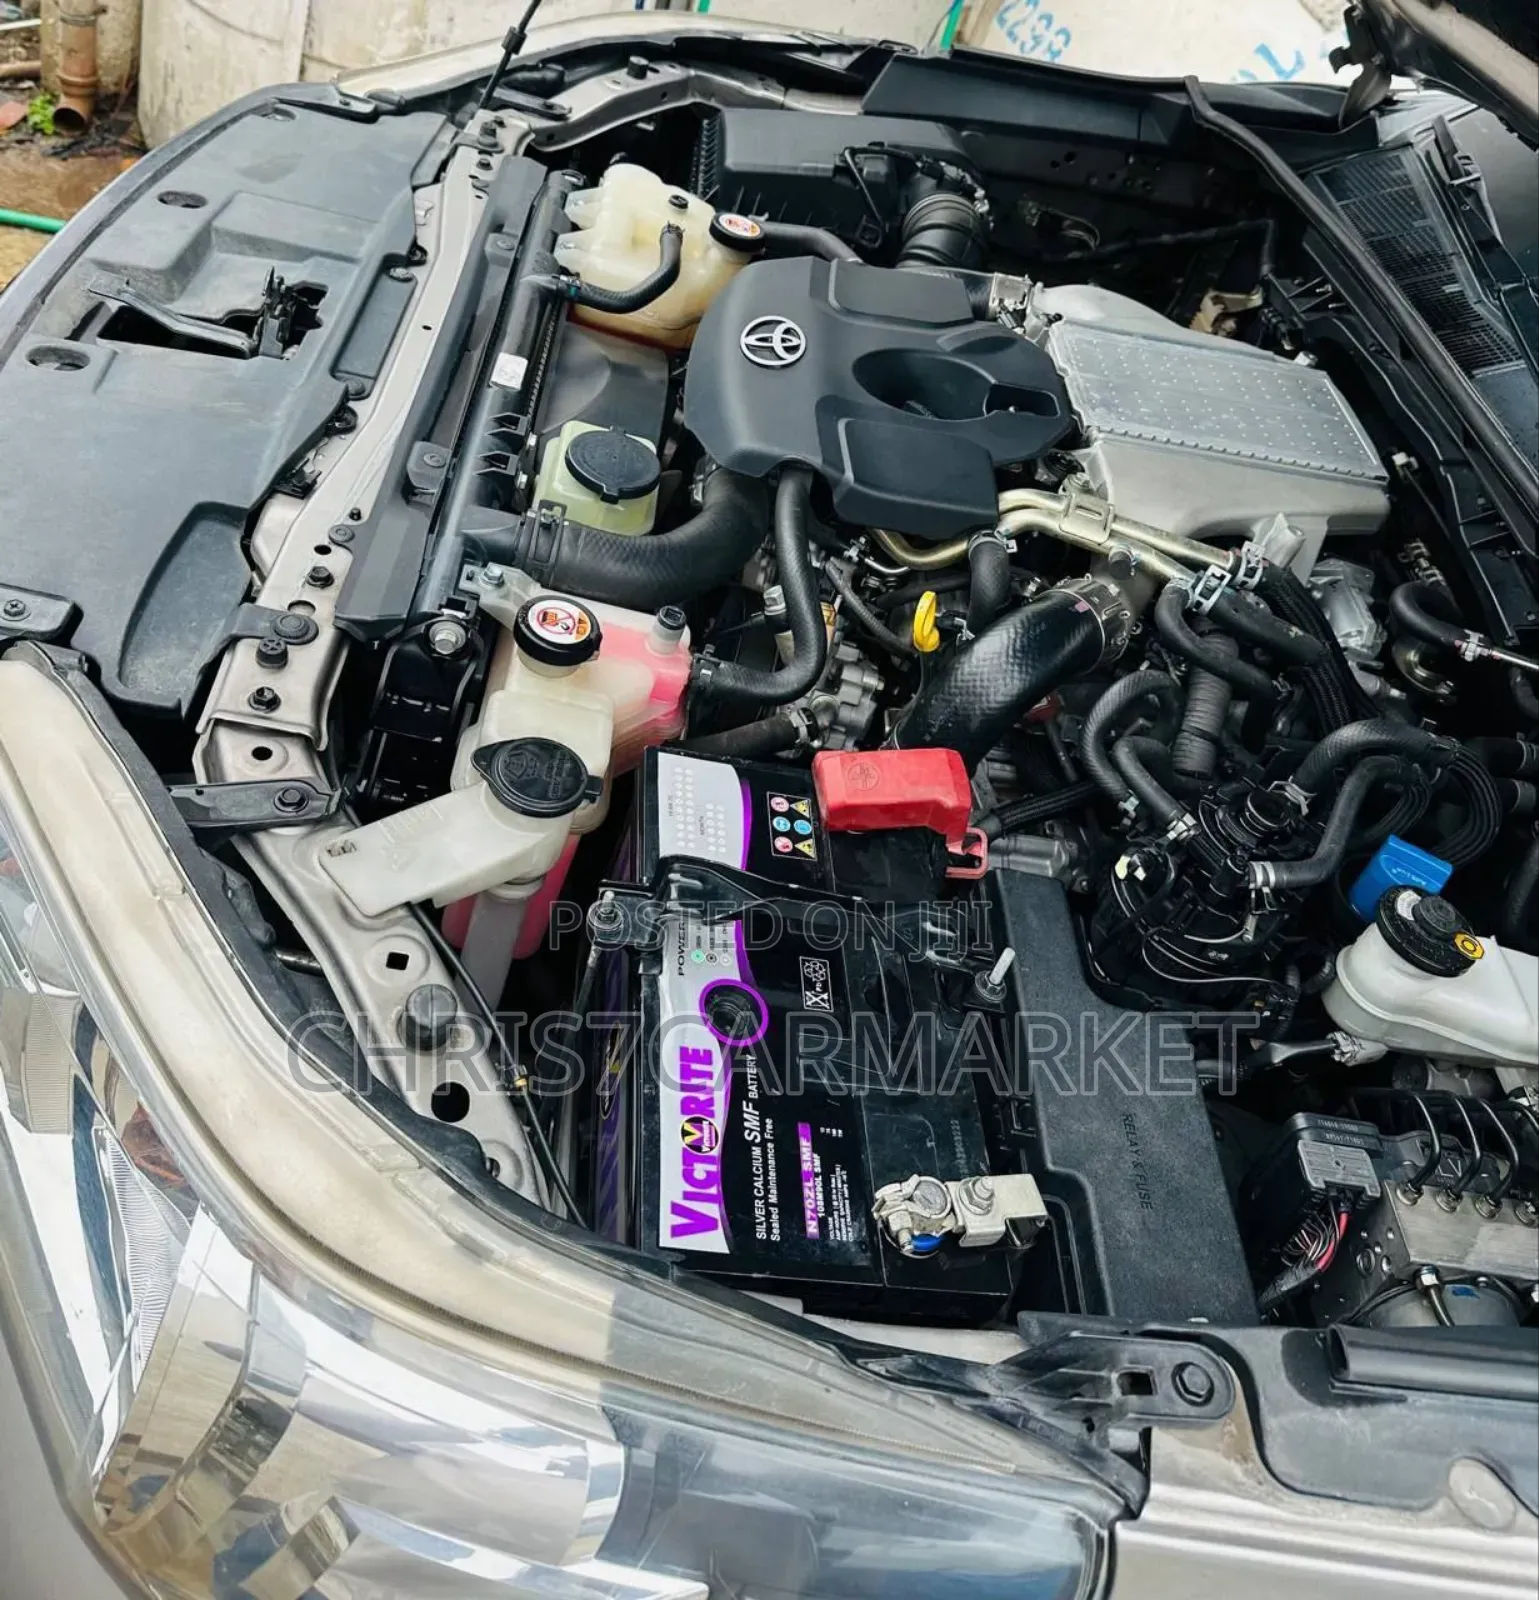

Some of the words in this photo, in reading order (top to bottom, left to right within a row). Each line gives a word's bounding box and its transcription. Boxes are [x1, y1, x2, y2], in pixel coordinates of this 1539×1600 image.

[745, 1054, 759, 1099] BATTERY
[742, 1101, 761, 1143] SMF
[763, 1118, 775, 1140] Free
[751, 1146, 765, 1197] CALCIUM
[766, 1142, 779, 1204] Maintenance
[801, 1136, 814, 1172] SMF
[812, 1152, 822, 1173] SMF
[1122, 1113, 1141, 1156] RELAY
[1135, 1173, 1154, 1210] FUSE
[755, 1199, 768, 1240] SILVER
[769, 1207, 781, 1241] Sealed
[804, 1180, 818, 1233] N70ZL
